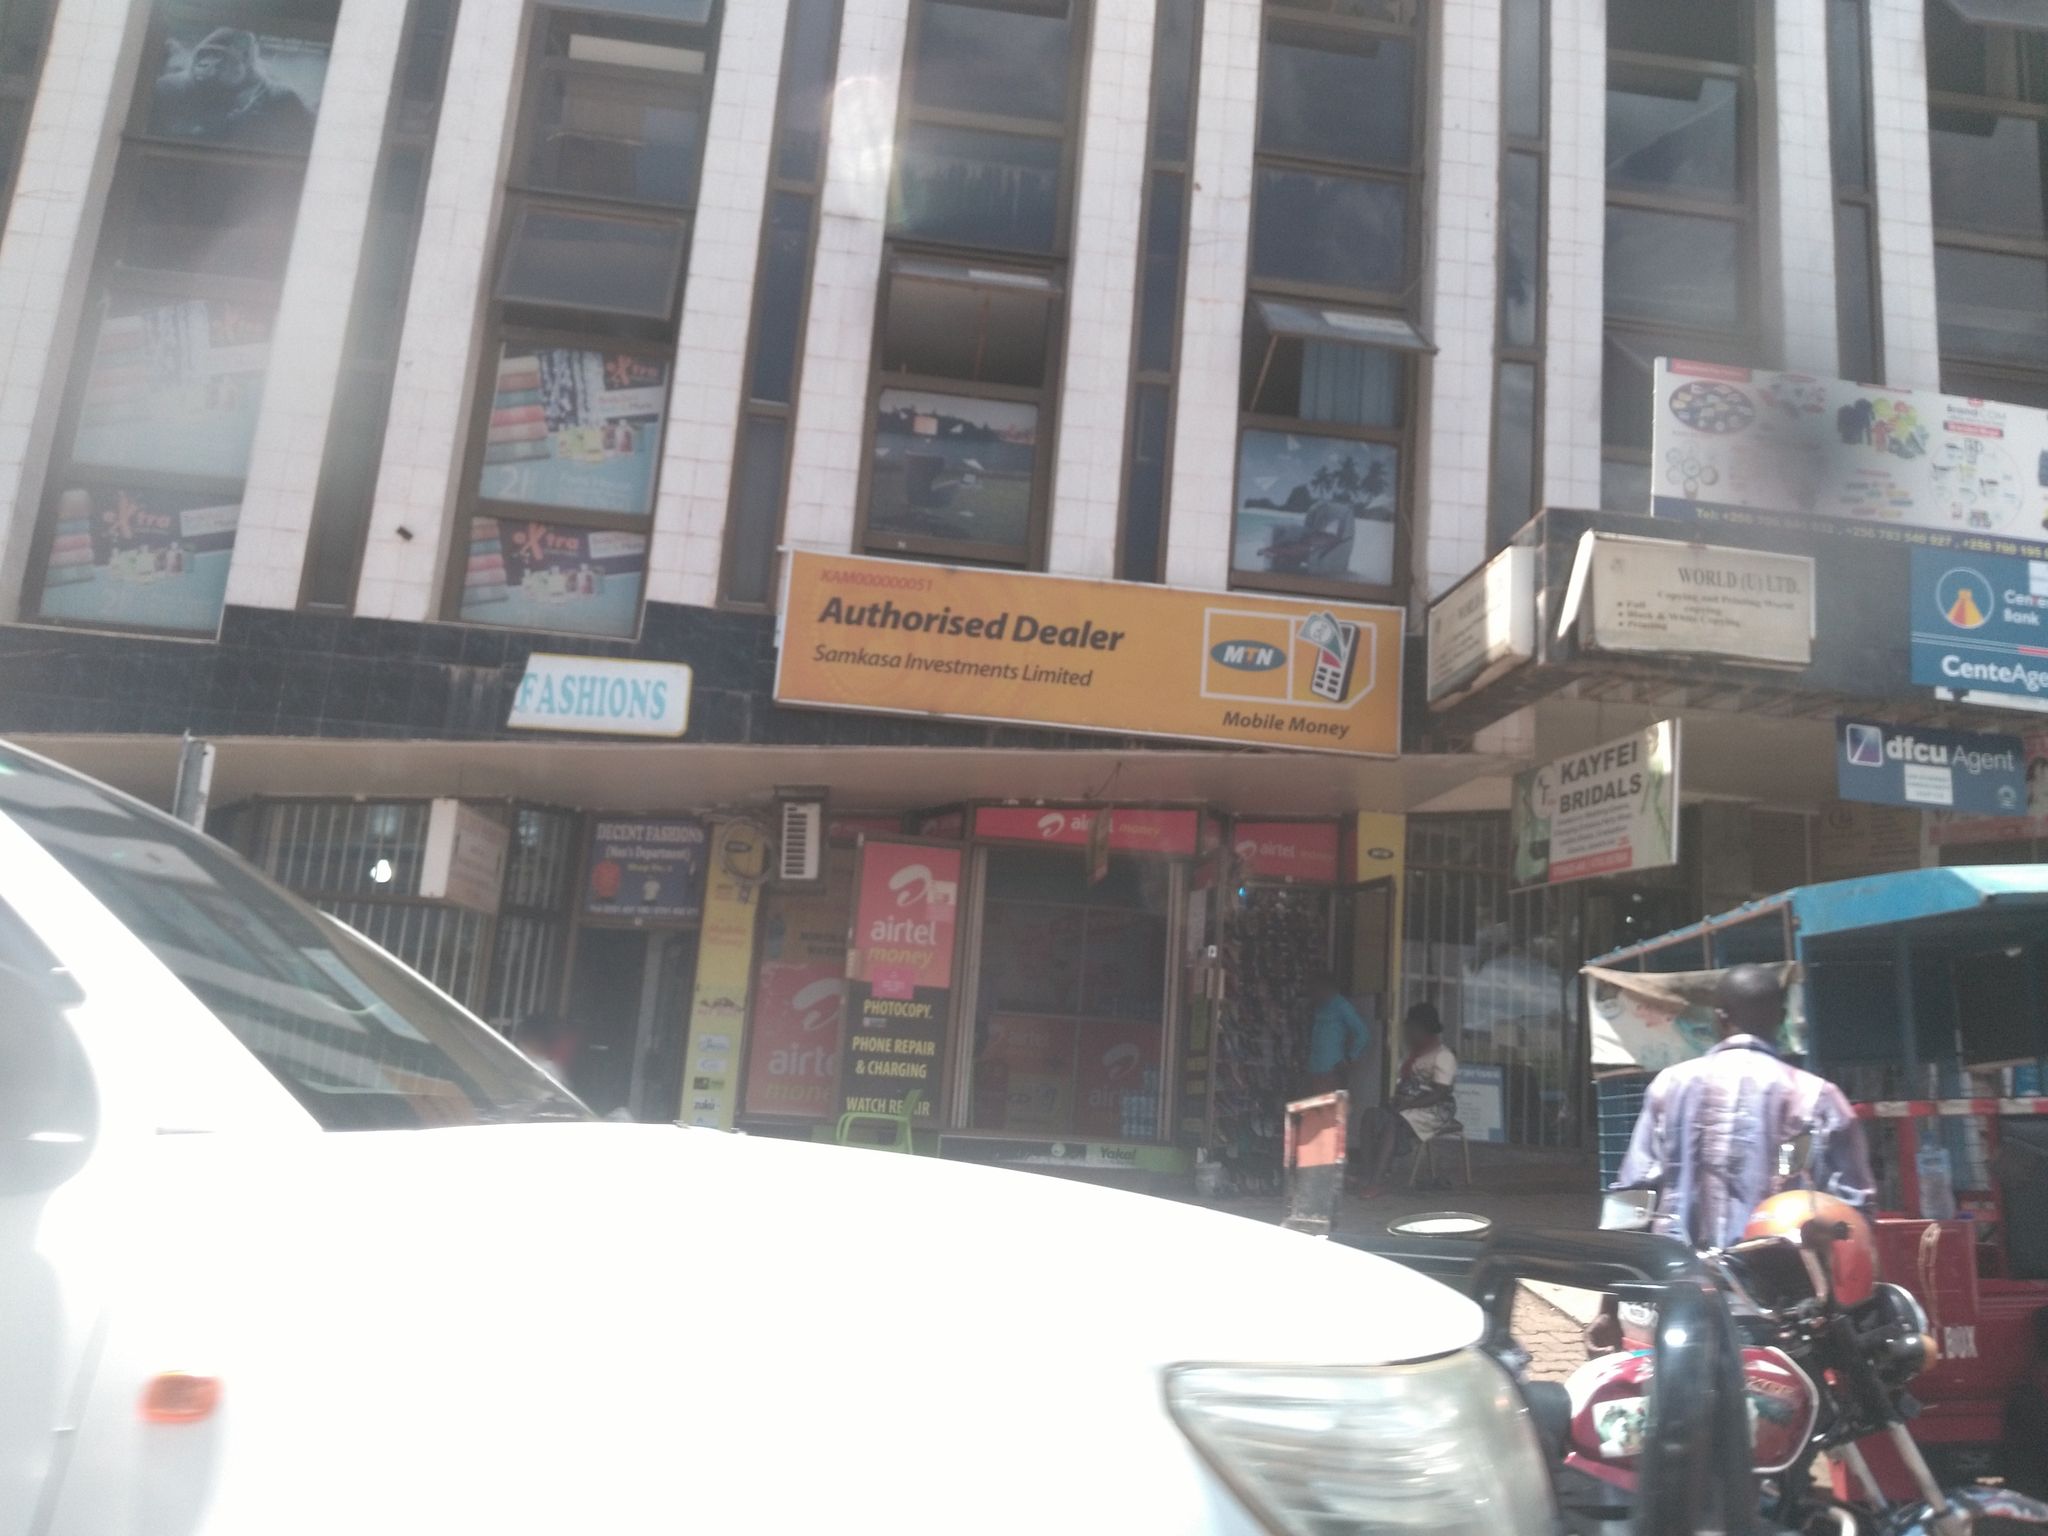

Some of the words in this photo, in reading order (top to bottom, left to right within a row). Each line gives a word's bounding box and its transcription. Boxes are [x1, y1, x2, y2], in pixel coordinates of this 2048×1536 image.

[1678, 566, 1738, 589] WORLD
[817, 597, 1009, 641] Authorised
[1012, 615, 1126, 653] Dealer
[2003, 607, 2041, 626] Bank
[813, 644, 901, 669] Samkasa
[905, 653, 1018, 682] Investments
[1022, 664, 1094, 688] Limited
[1222, 645, 1274, 667] MTN
[512, 672, 667, 721] FASHIONS
[1222, 710, 1285, 732] Mobile
[1288, 716, 1350, 740] Money
[1561, 740, 1638, 785] KAYFEI
[1886, 735, 1948, 764] dfcu
[1951, 744, 2016, 776] Agent
[1559, 772, 1643, 815] BRIDALS
[870, 915, 936, 946] airtel
[868, 947, 935, 970] money
[852, 1035, 893, 1053] PHONE
[894, 1038, 936, 1057] REPAIR
[855, 1060, 866, 1075] &
[867, 1060, 928, 1079] CHARGING
[846, 1096, 887, 1113] WATCH
[888, 1100, 930, 1117] REIR
